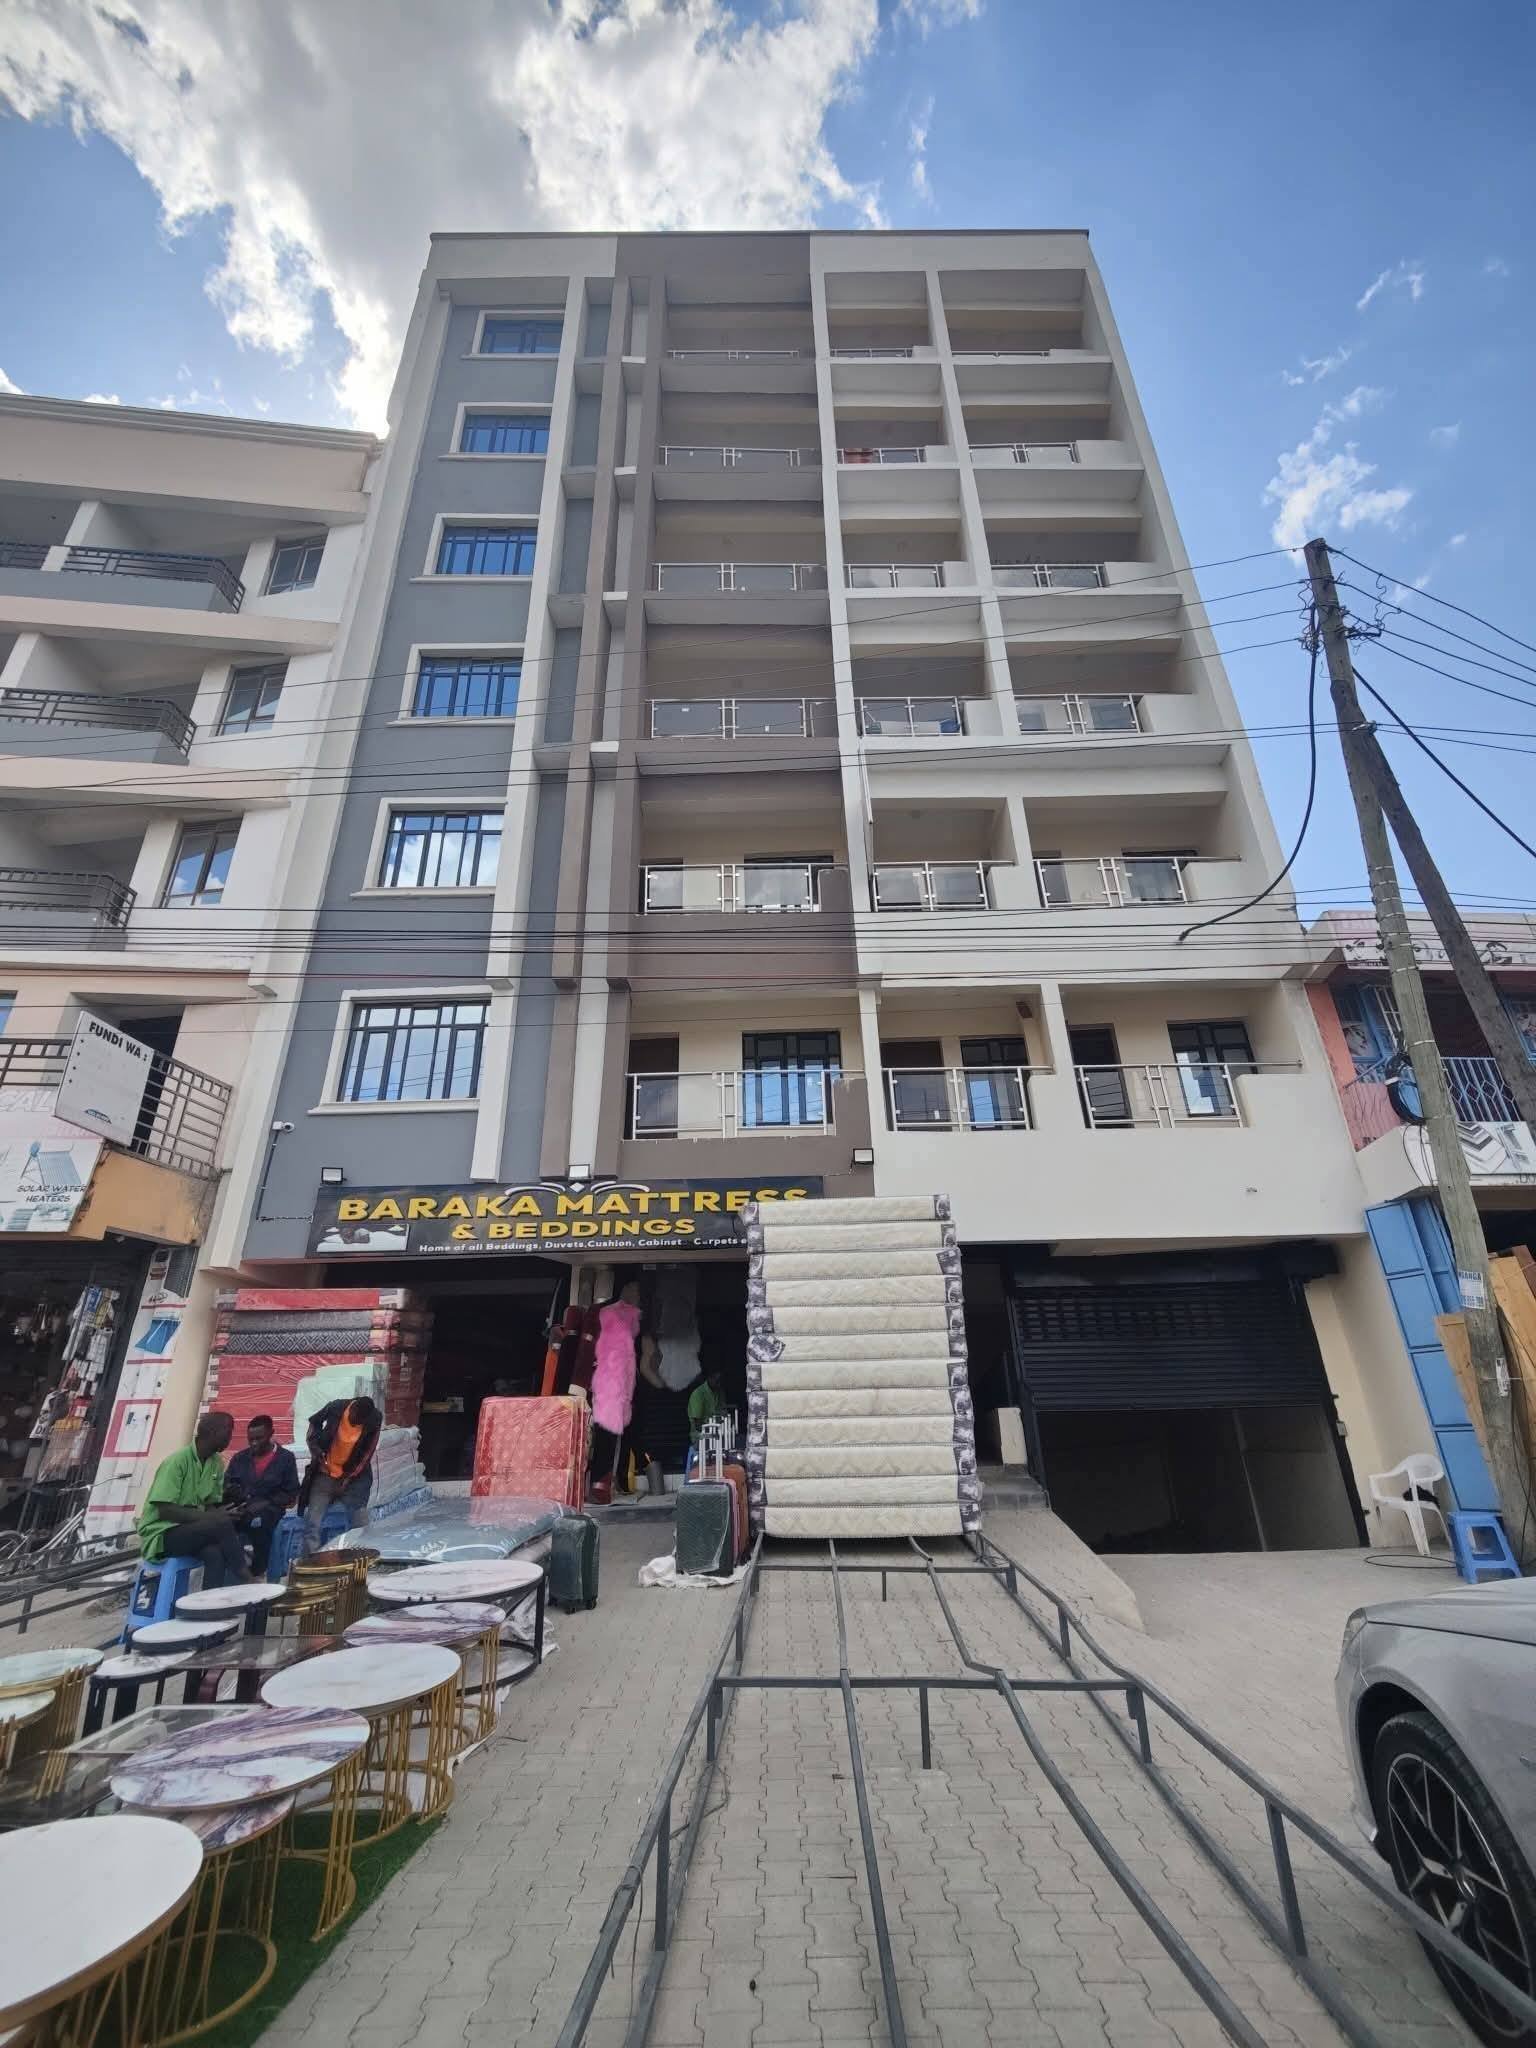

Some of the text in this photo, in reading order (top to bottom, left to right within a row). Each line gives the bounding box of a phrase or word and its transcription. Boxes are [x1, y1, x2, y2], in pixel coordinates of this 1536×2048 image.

[89, 1021, 123, 1048] FUNDI
[17, 1184, 87, 1193] SOLAR WATER
[26, 1195, 71, 1203] HEATERS
[338, 1188, 808, 1220] BARAKA MATTRESS
[452, 1218, 696, 1240] & BEDDINGS
[419, 1244, 450, 1252] Home
[453, 1243, 466, 1251] of
[468, 1242, 483, 1250] all
